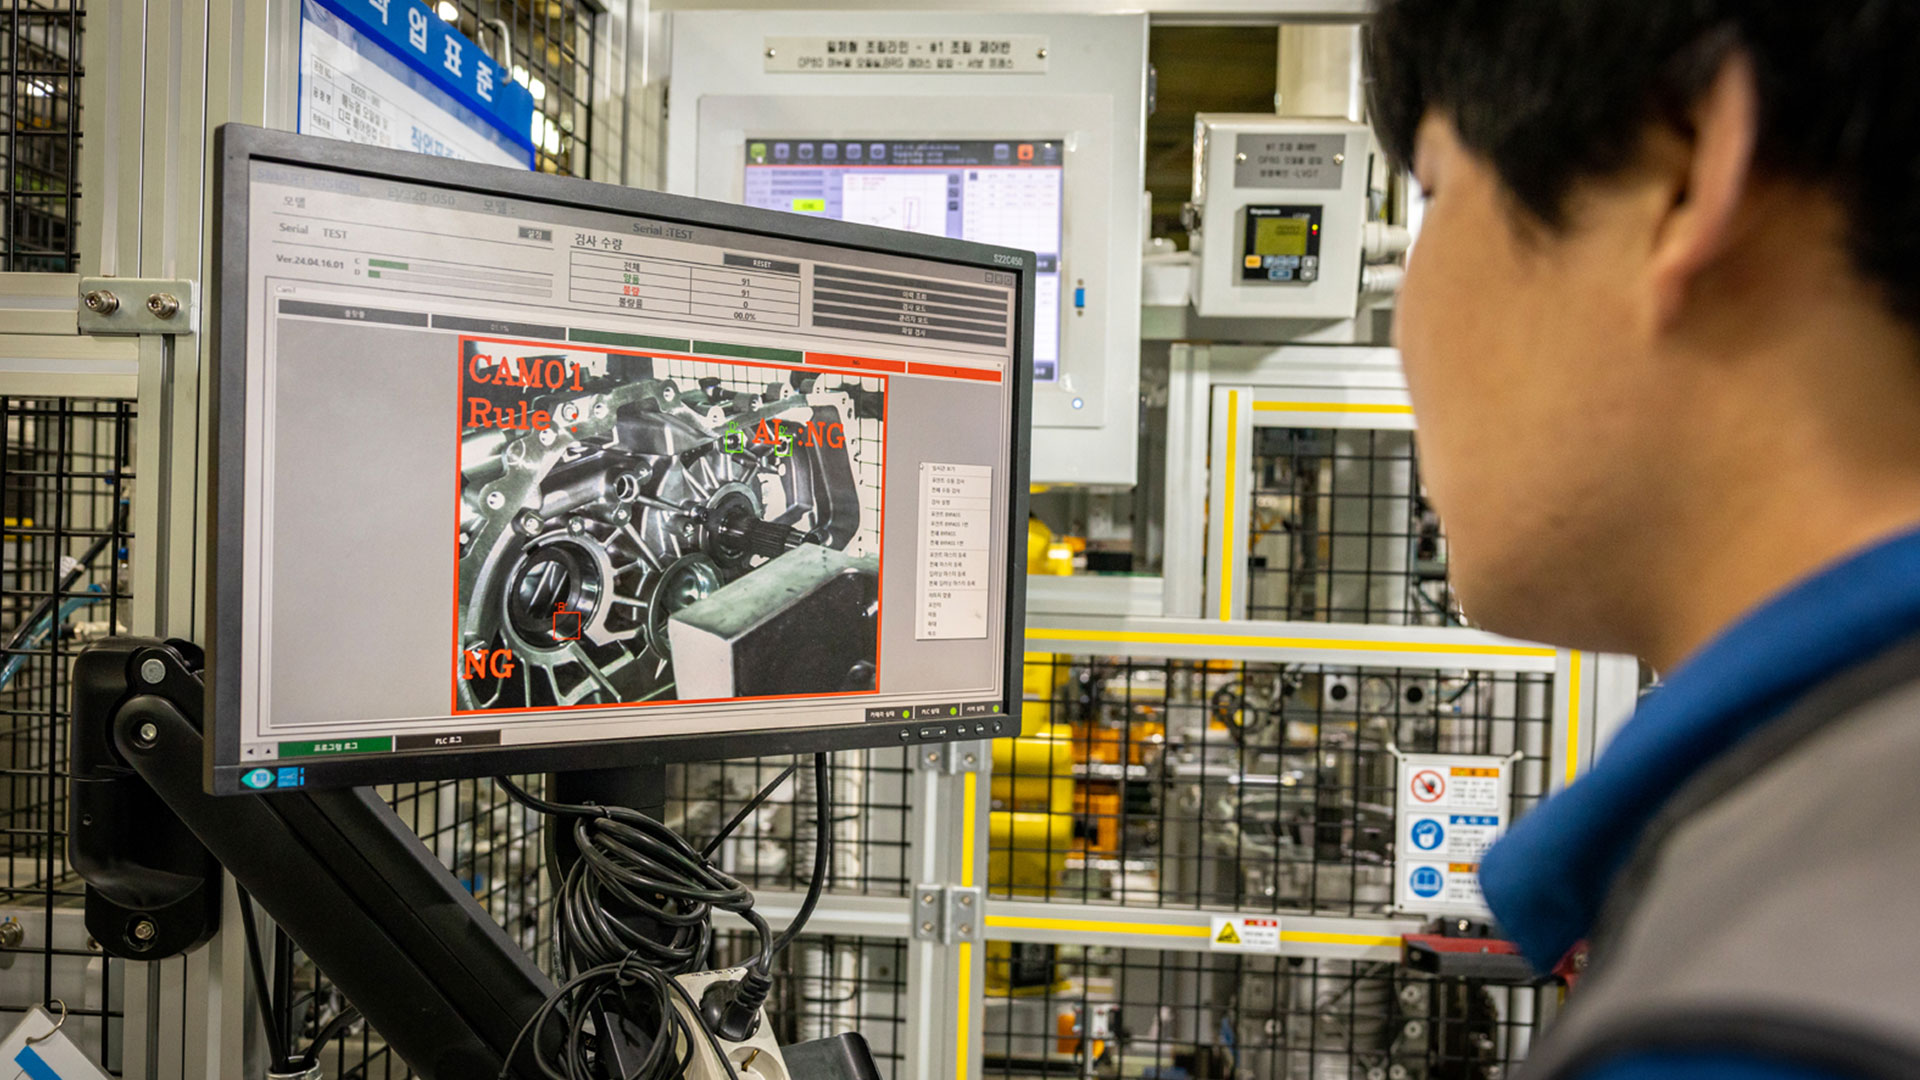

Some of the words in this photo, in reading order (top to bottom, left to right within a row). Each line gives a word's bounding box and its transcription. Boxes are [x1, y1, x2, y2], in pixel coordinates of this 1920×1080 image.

[283, 195, 306, 209] 모델
[279, 222, 309, 235] Serial
[322, 228, 349, 240] TEST
[633, 222, 662, 236] Serial
[666, 227, 695, 241] :TEST
[575, 232, 597, 248] 검사
[601, 236, 623, 251] 수량
[276, 253, 344, 270] Ver.24.04.16.01
[623, 261, 641, 273] 전체
[752, 259, 772, 269] RESET
[623, 273, 640, 286] 양품
[741, 278, 751, 287] 91
[622, 285, 641, 297] 불량
[741, 289, 750, 298] 91
[743, 301, 749, 309] 0
[733, 311, 757, 321] 00.0%
[468, 353, 584, 392] CAM01
[466, 396, 551, 431] Rule
[752, 417, 783, 445] AI
[462, 648, 515, 680] NG
[313, 742, 343, 752] 프로그램
[344, 742, 358, 750] 로그
[435, 737, 448, 745] PLC
[449, 736, 463, 744] 로그
